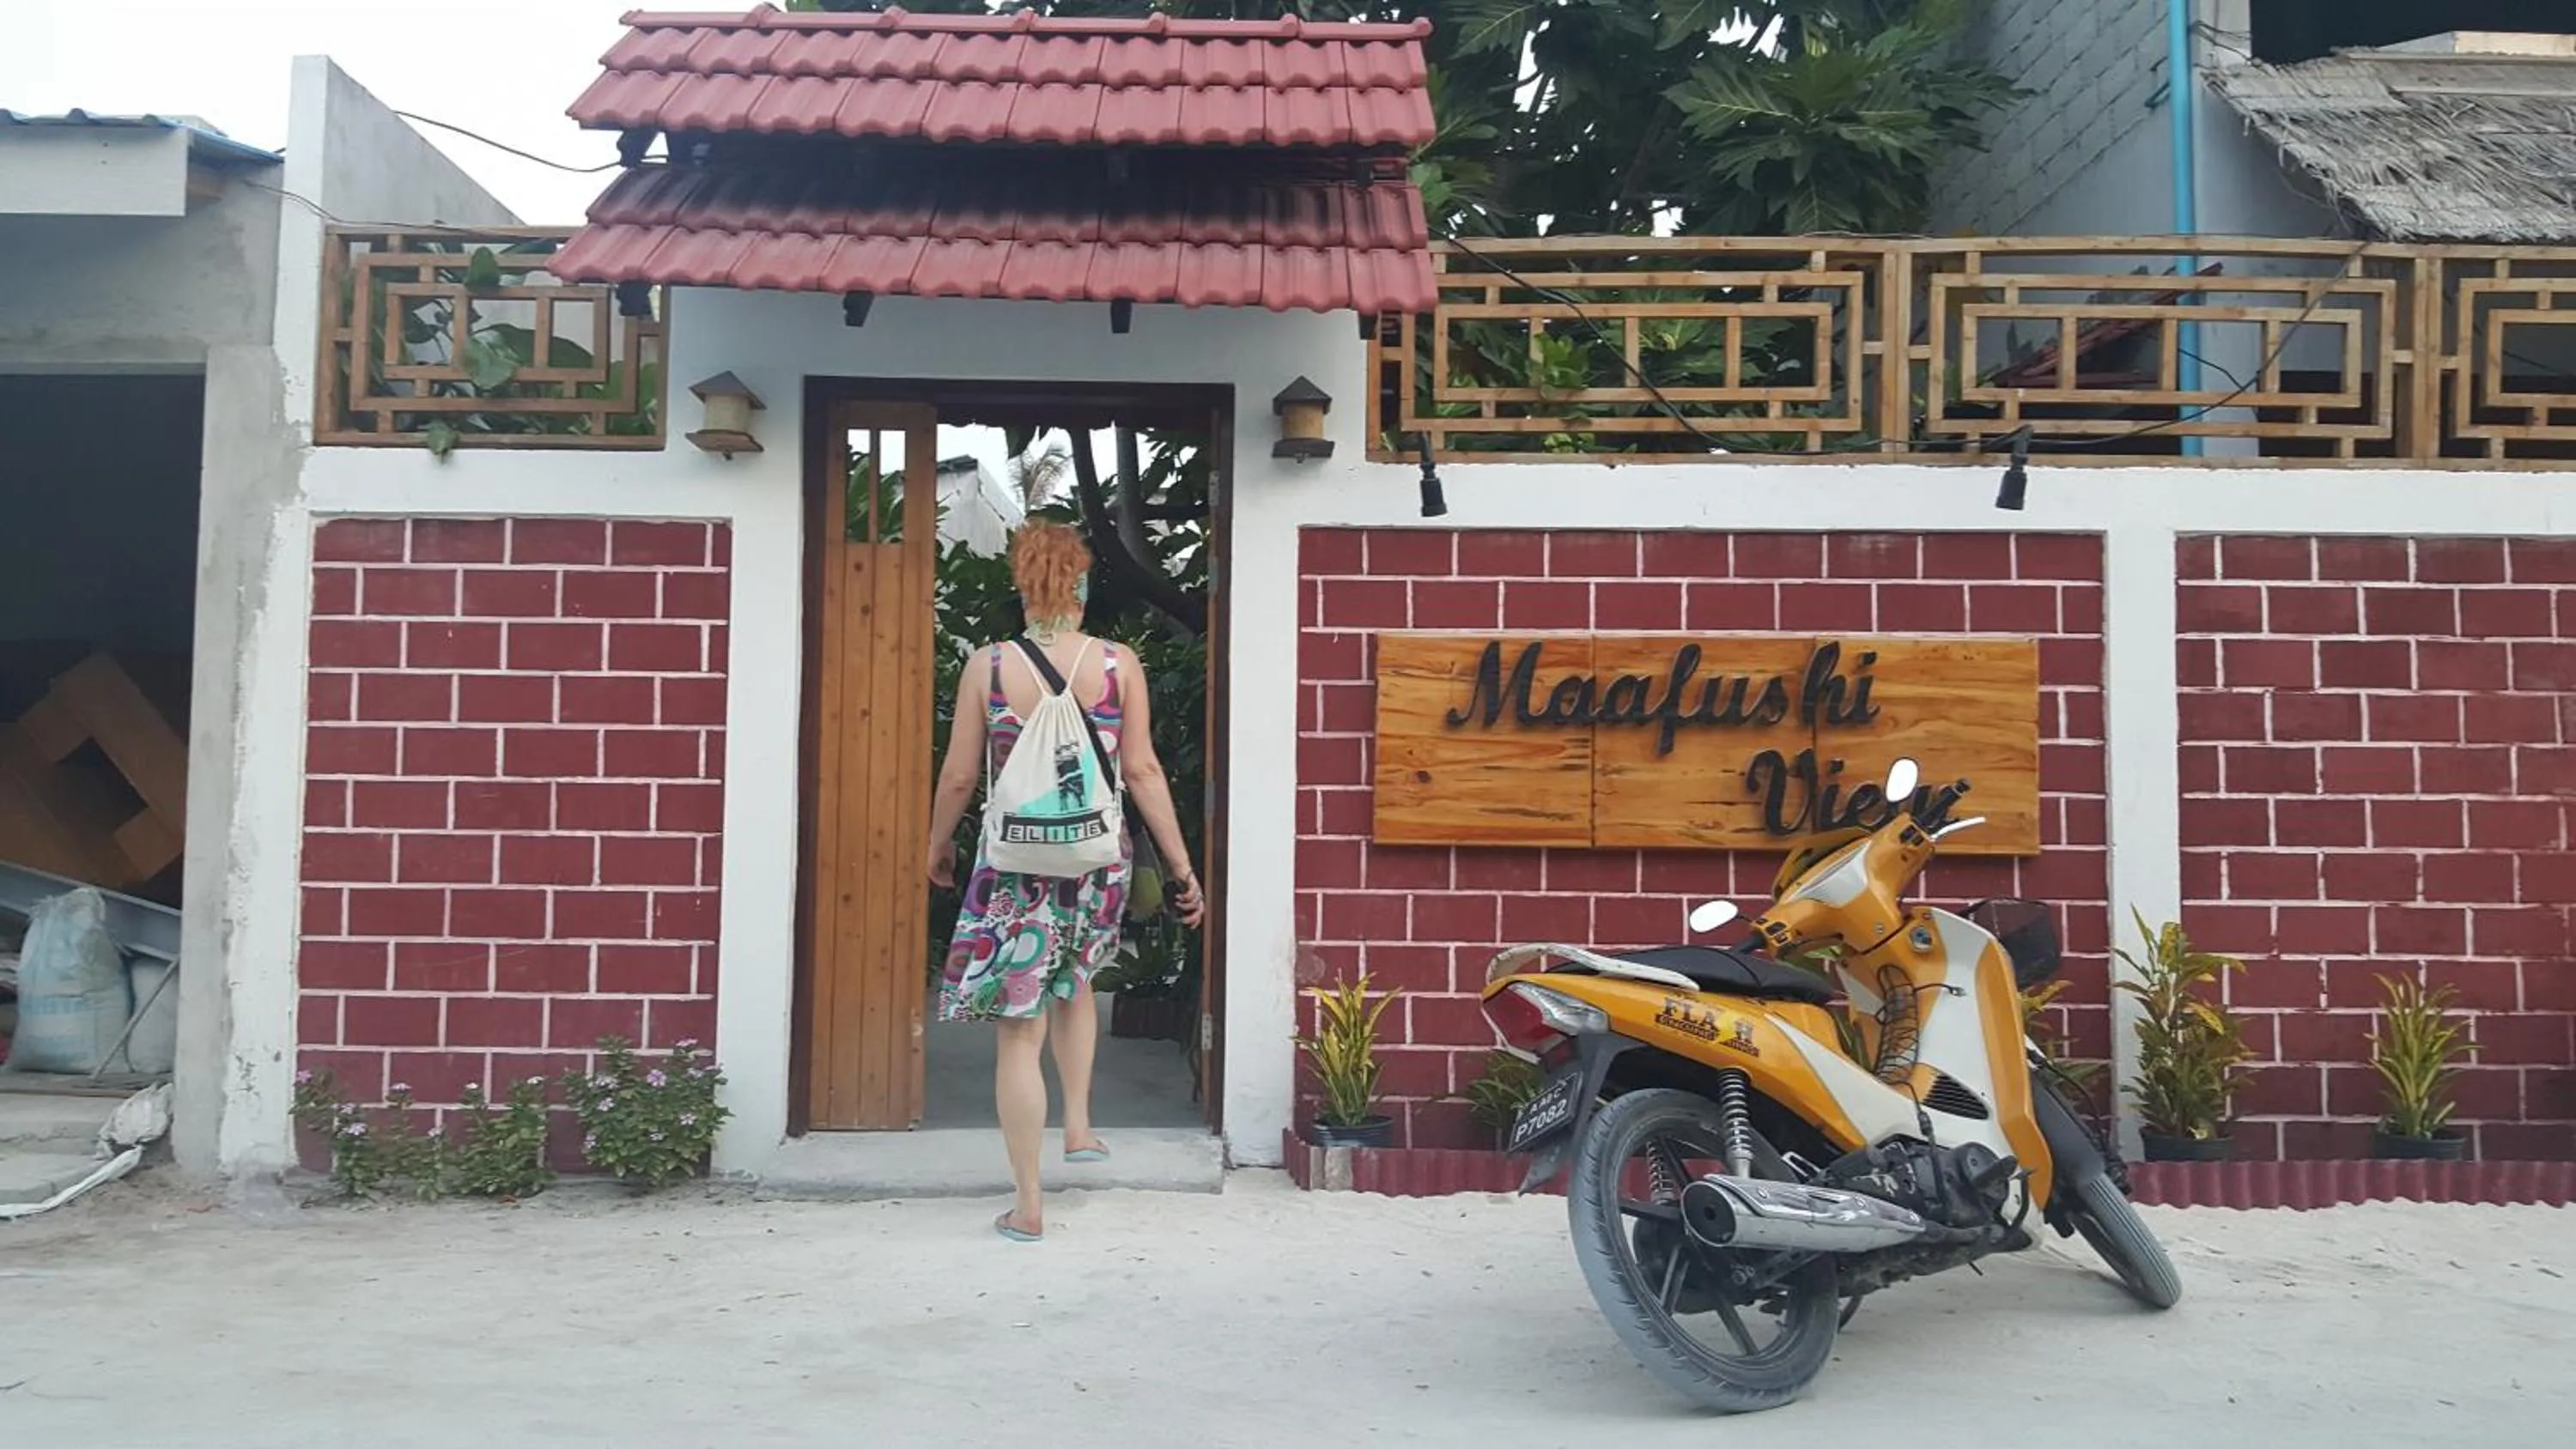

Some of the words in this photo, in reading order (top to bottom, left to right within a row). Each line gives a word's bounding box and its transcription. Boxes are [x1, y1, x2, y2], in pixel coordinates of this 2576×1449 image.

[1448, 640, 1880, 755] Maafushi
[1009, 821, 1099, 841] ELITE
[1515, 1099, 1567, 1143] P7082
